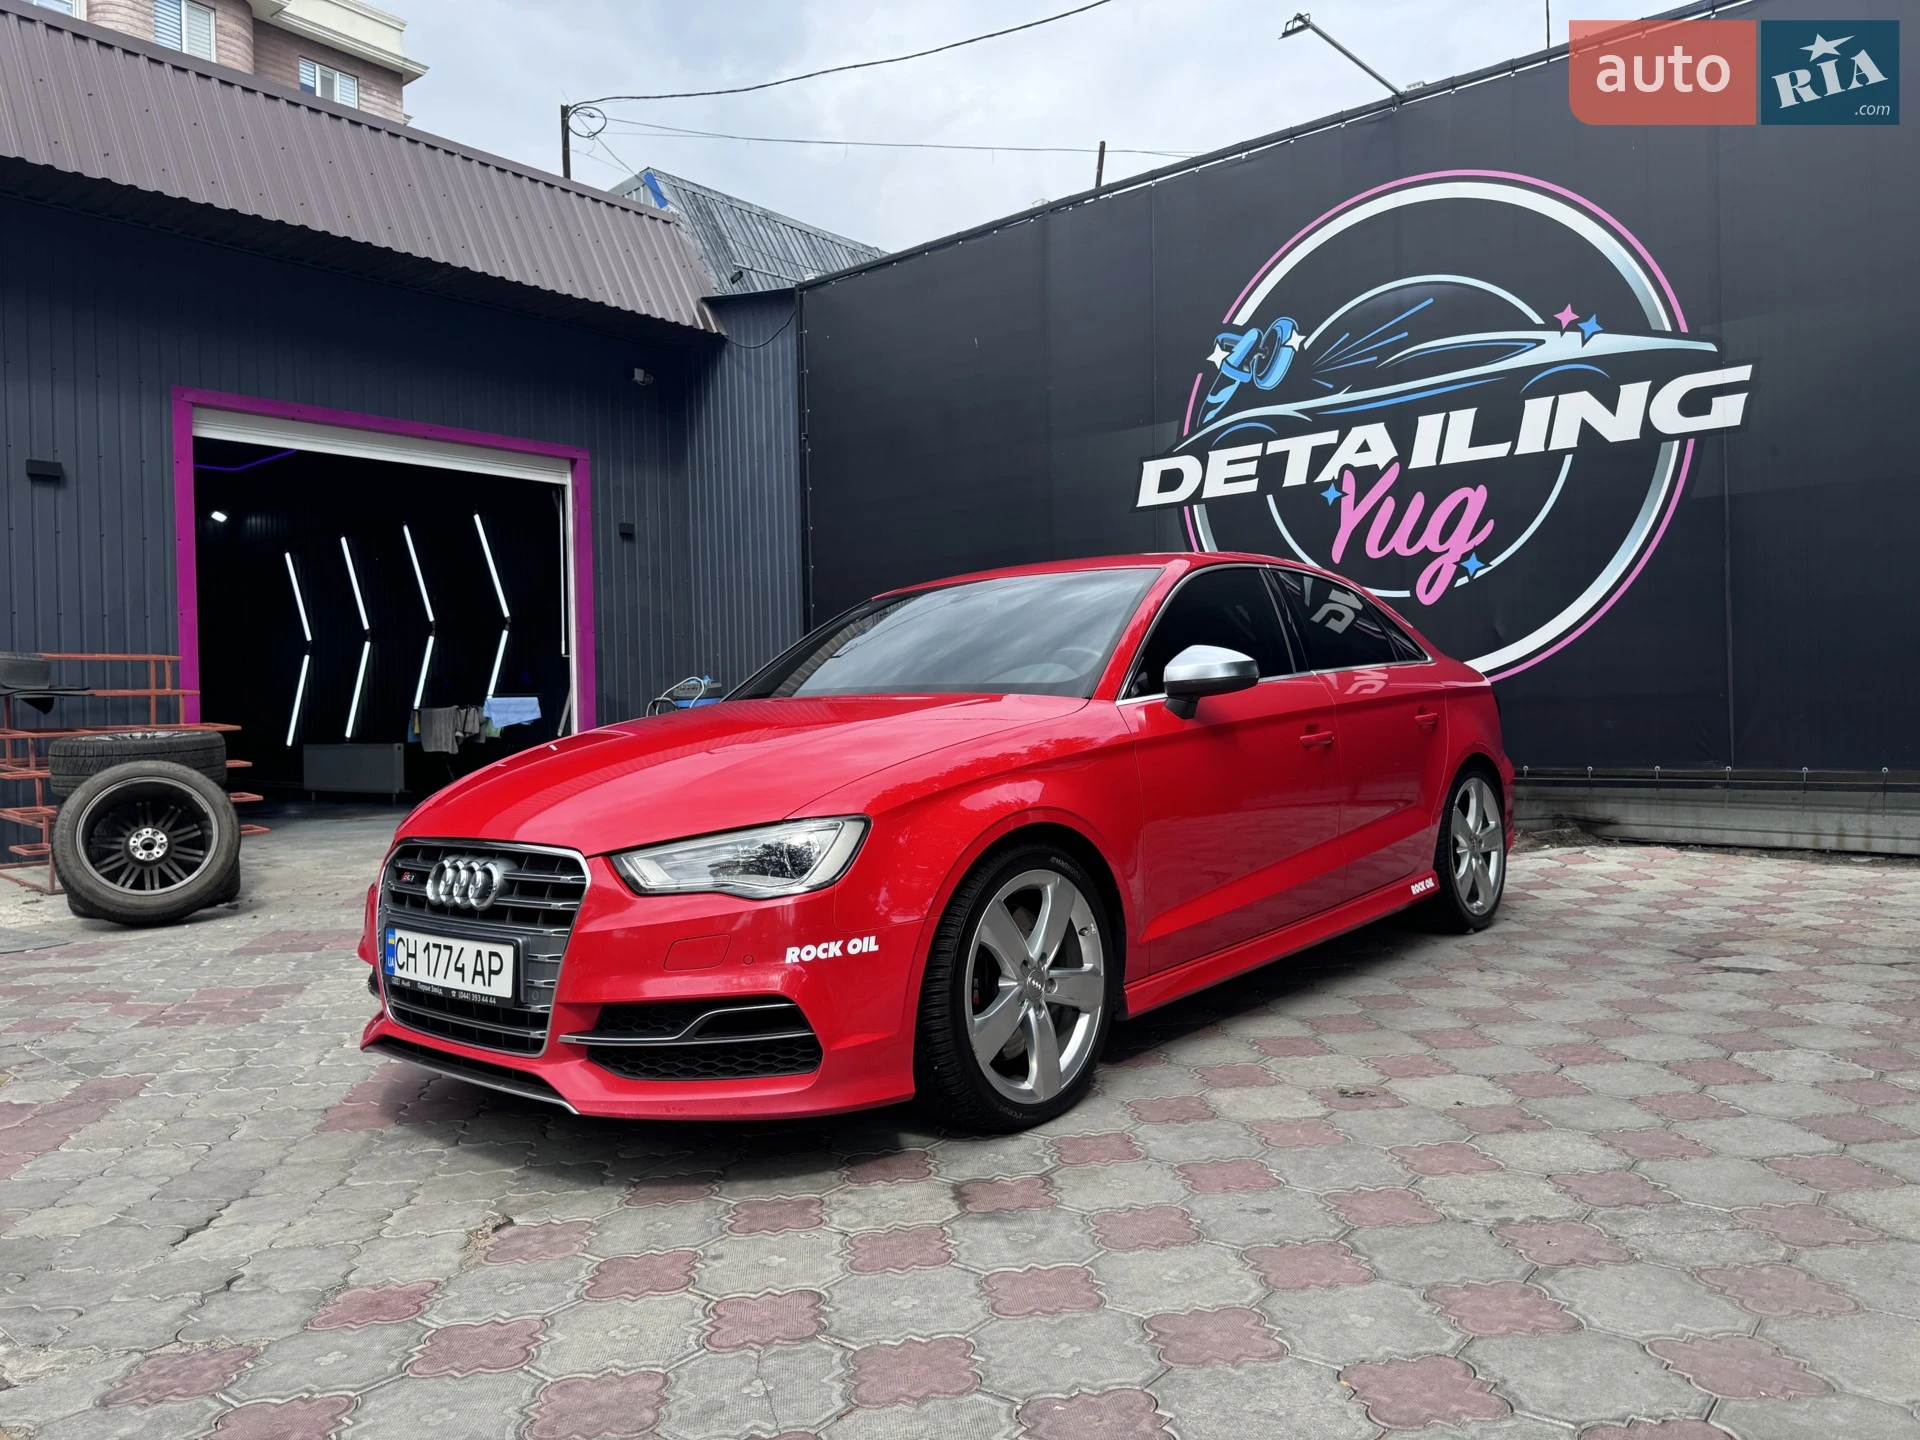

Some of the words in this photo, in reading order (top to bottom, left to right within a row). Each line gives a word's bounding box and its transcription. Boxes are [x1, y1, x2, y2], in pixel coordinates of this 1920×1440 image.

[1136, 364, 1754, 508] DETAILING
[1330, 462, 1495, 606] Yug
[1410, 880, 1427, 895] ROCK
[1425, 877, 1435, 889] OIL
[387, 956, 395, 967] UA
[396, 936, 417, 974] CH
[423, 941, 465, 983] 1774
[471, 949, 504, 987] AP
[785, 940, 844, 964] ROCK
[847, 935, 880, 955] OIL
